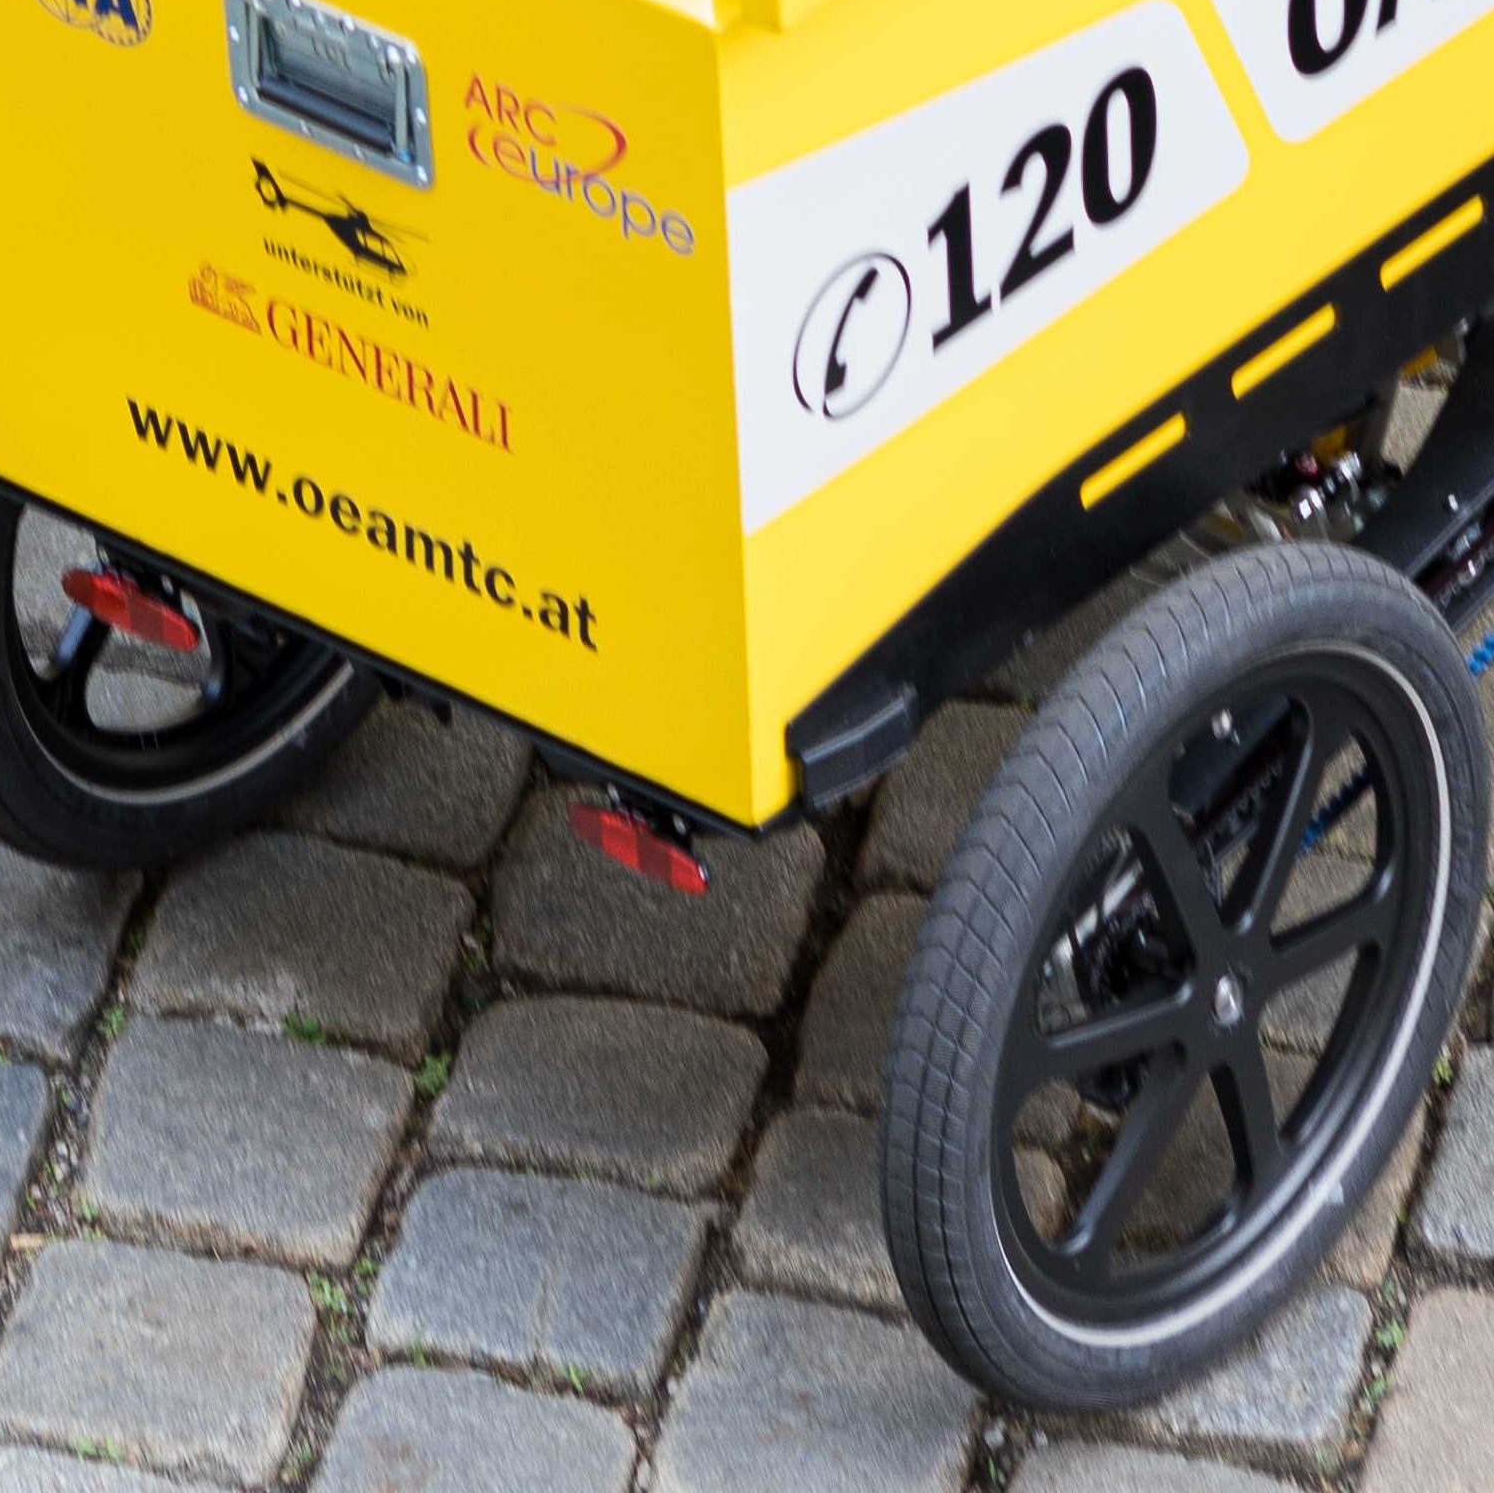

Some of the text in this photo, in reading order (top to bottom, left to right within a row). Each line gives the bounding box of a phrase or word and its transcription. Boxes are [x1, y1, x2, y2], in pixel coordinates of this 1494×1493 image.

[465, 69, 558, 148] ARC
[491, 132, 696, 256] europe
[927, 65, 1158, 355] 120
[265, 295, 514, 455] GENERALI
[389, 295, 430, 340] von
[126, 395, 600, 654] www.oeamtc.at
